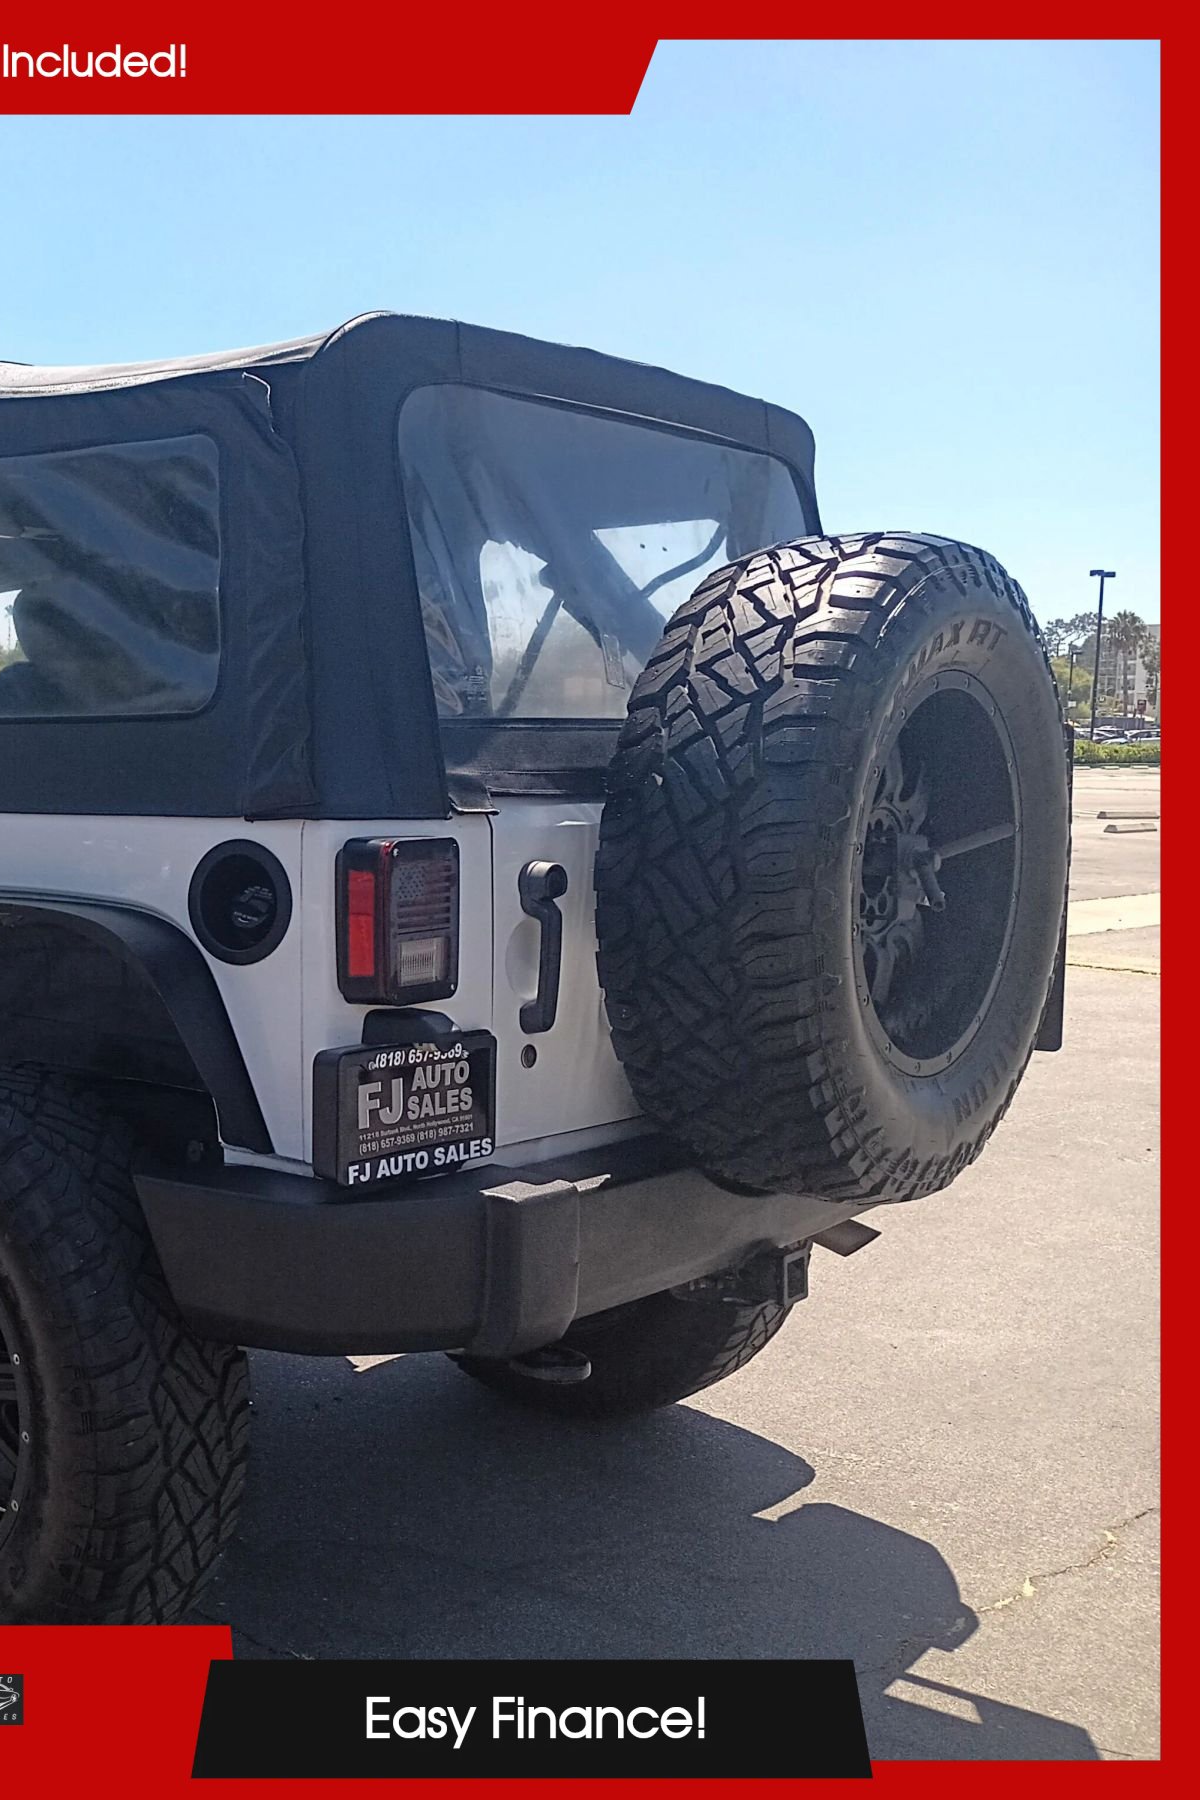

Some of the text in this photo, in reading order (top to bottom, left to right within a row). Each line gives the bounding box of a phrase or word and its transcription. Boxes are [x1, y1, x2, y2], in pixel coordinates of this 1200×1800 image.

[375, 1050, 405, 1069] (818)
[358, 1060, 470, 1130] FJ AUTO
[406, 1087, 473, 1121] SALES
[359, 1122, 474, 1156] (818) 657-9369 (818) 987-7321
[348, 1137, 492, 1185] FJ AUTO SALES
